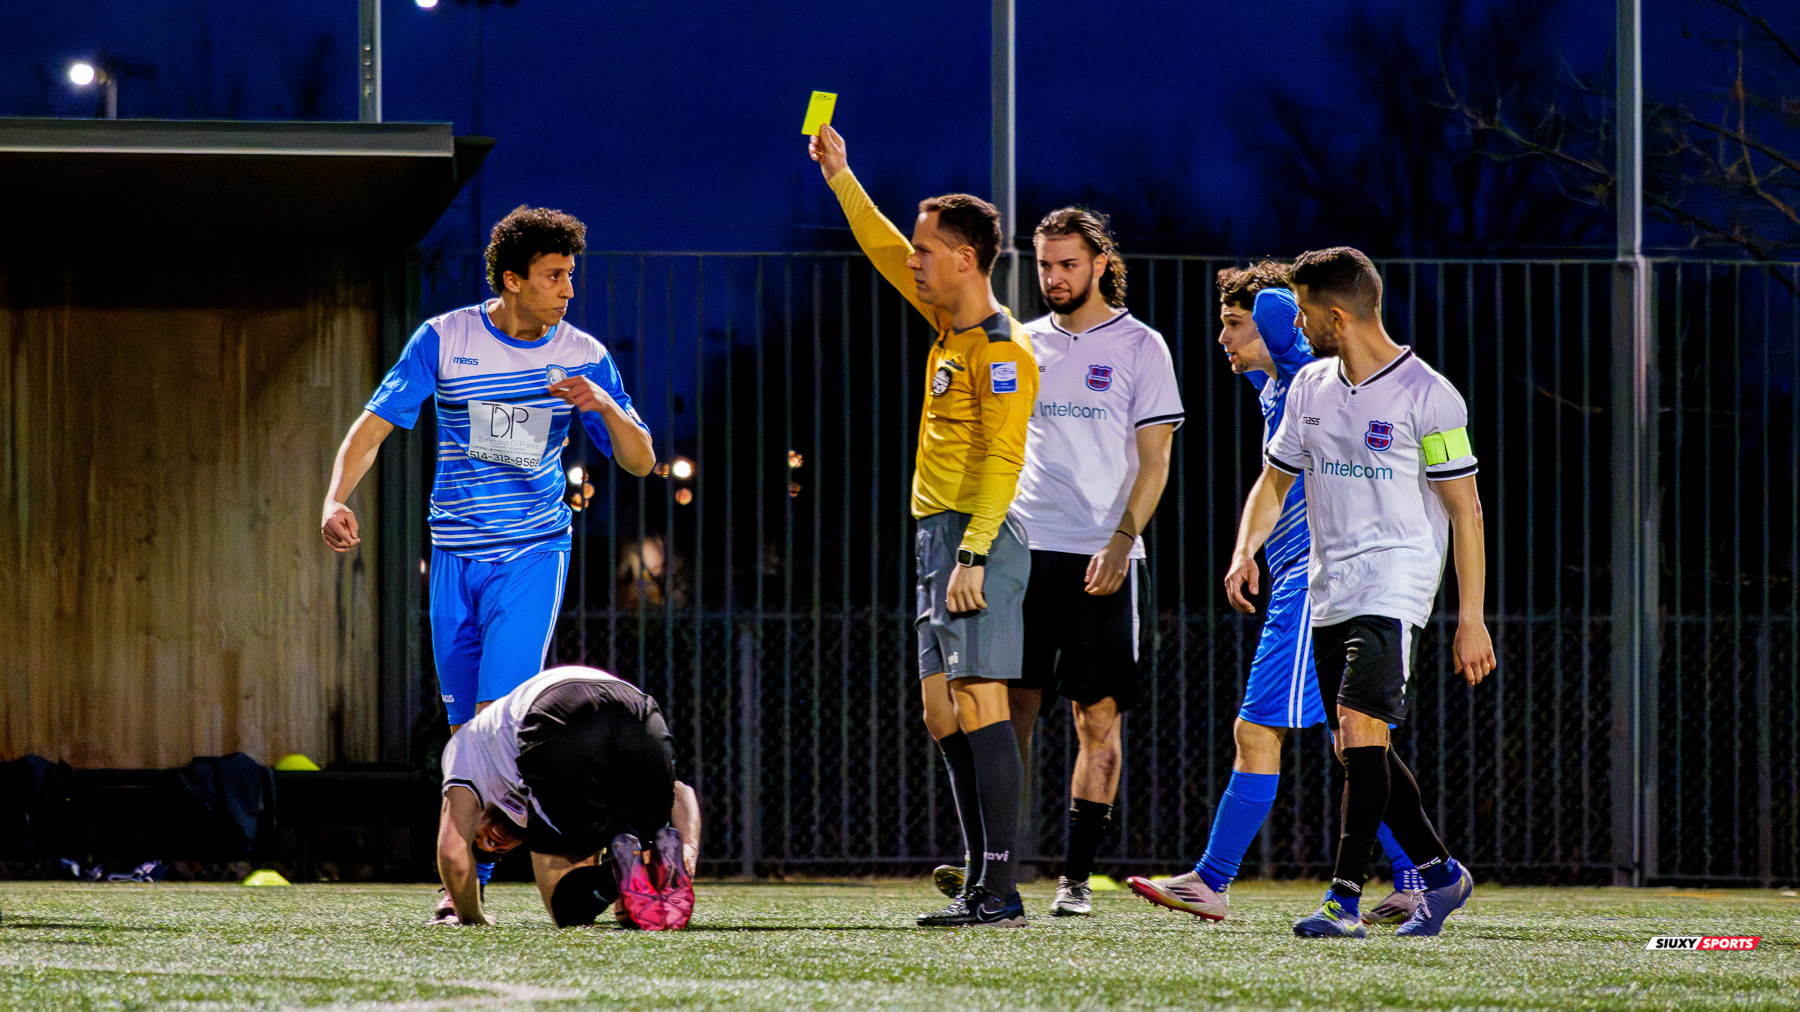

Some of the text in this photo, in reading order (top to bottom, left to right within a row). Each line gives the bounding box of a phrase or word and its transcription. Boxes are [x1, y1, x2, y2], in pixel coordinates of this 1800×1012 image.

[453, 356, 479, 366] mass
[1039, 401, 1107, 420] Intelcom
[1321, 457, 1393, 479] Intelcom
